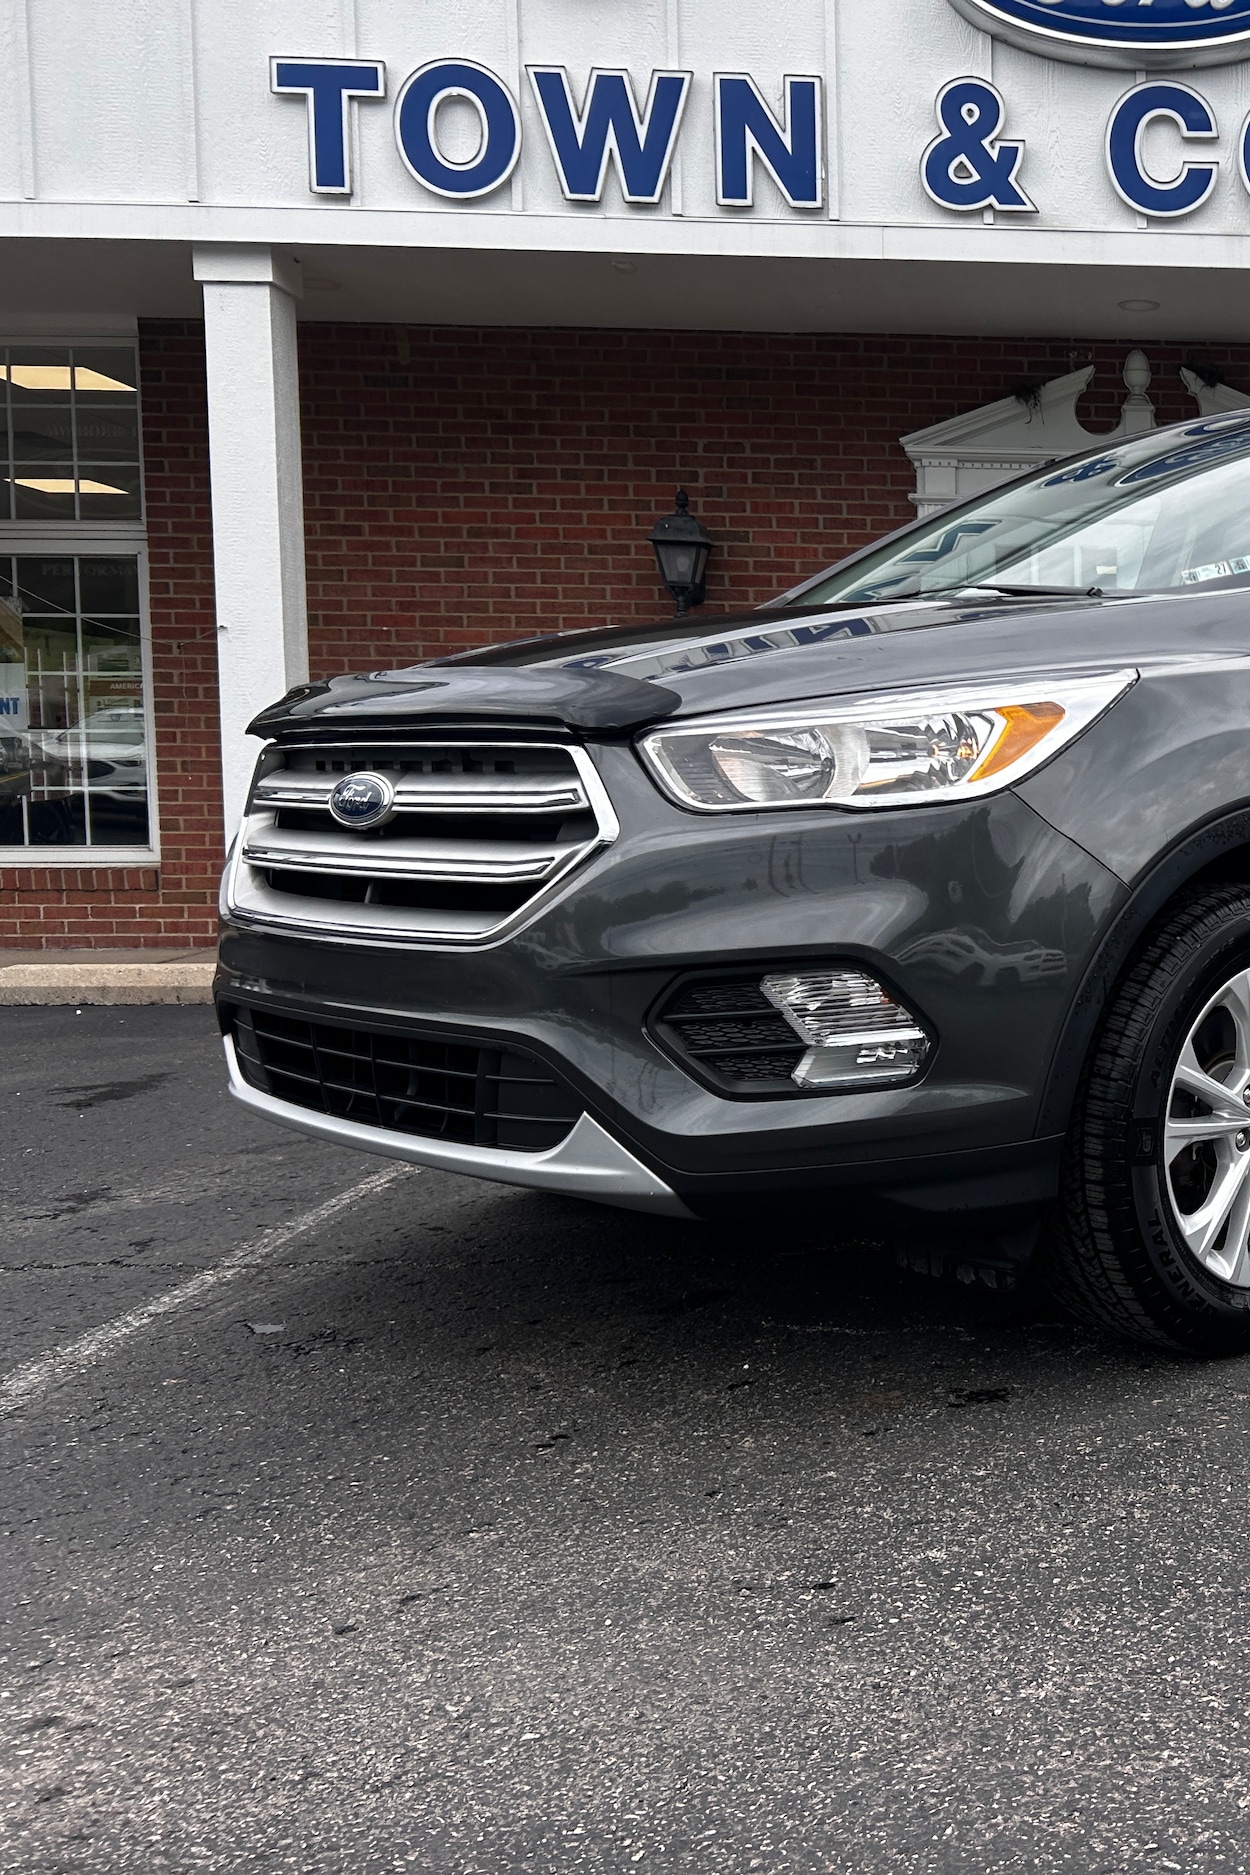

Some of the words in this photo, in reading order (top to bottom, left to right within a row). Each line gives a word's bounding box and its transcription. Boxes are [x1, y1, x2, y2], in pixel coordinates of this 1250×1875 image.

[269, 55, 824, 209] TOWN
[920, 75, 1039, 212] &
[334, 783, 374, 812] Ford
[1147, 1207, 1219, 1321] GENERAL
